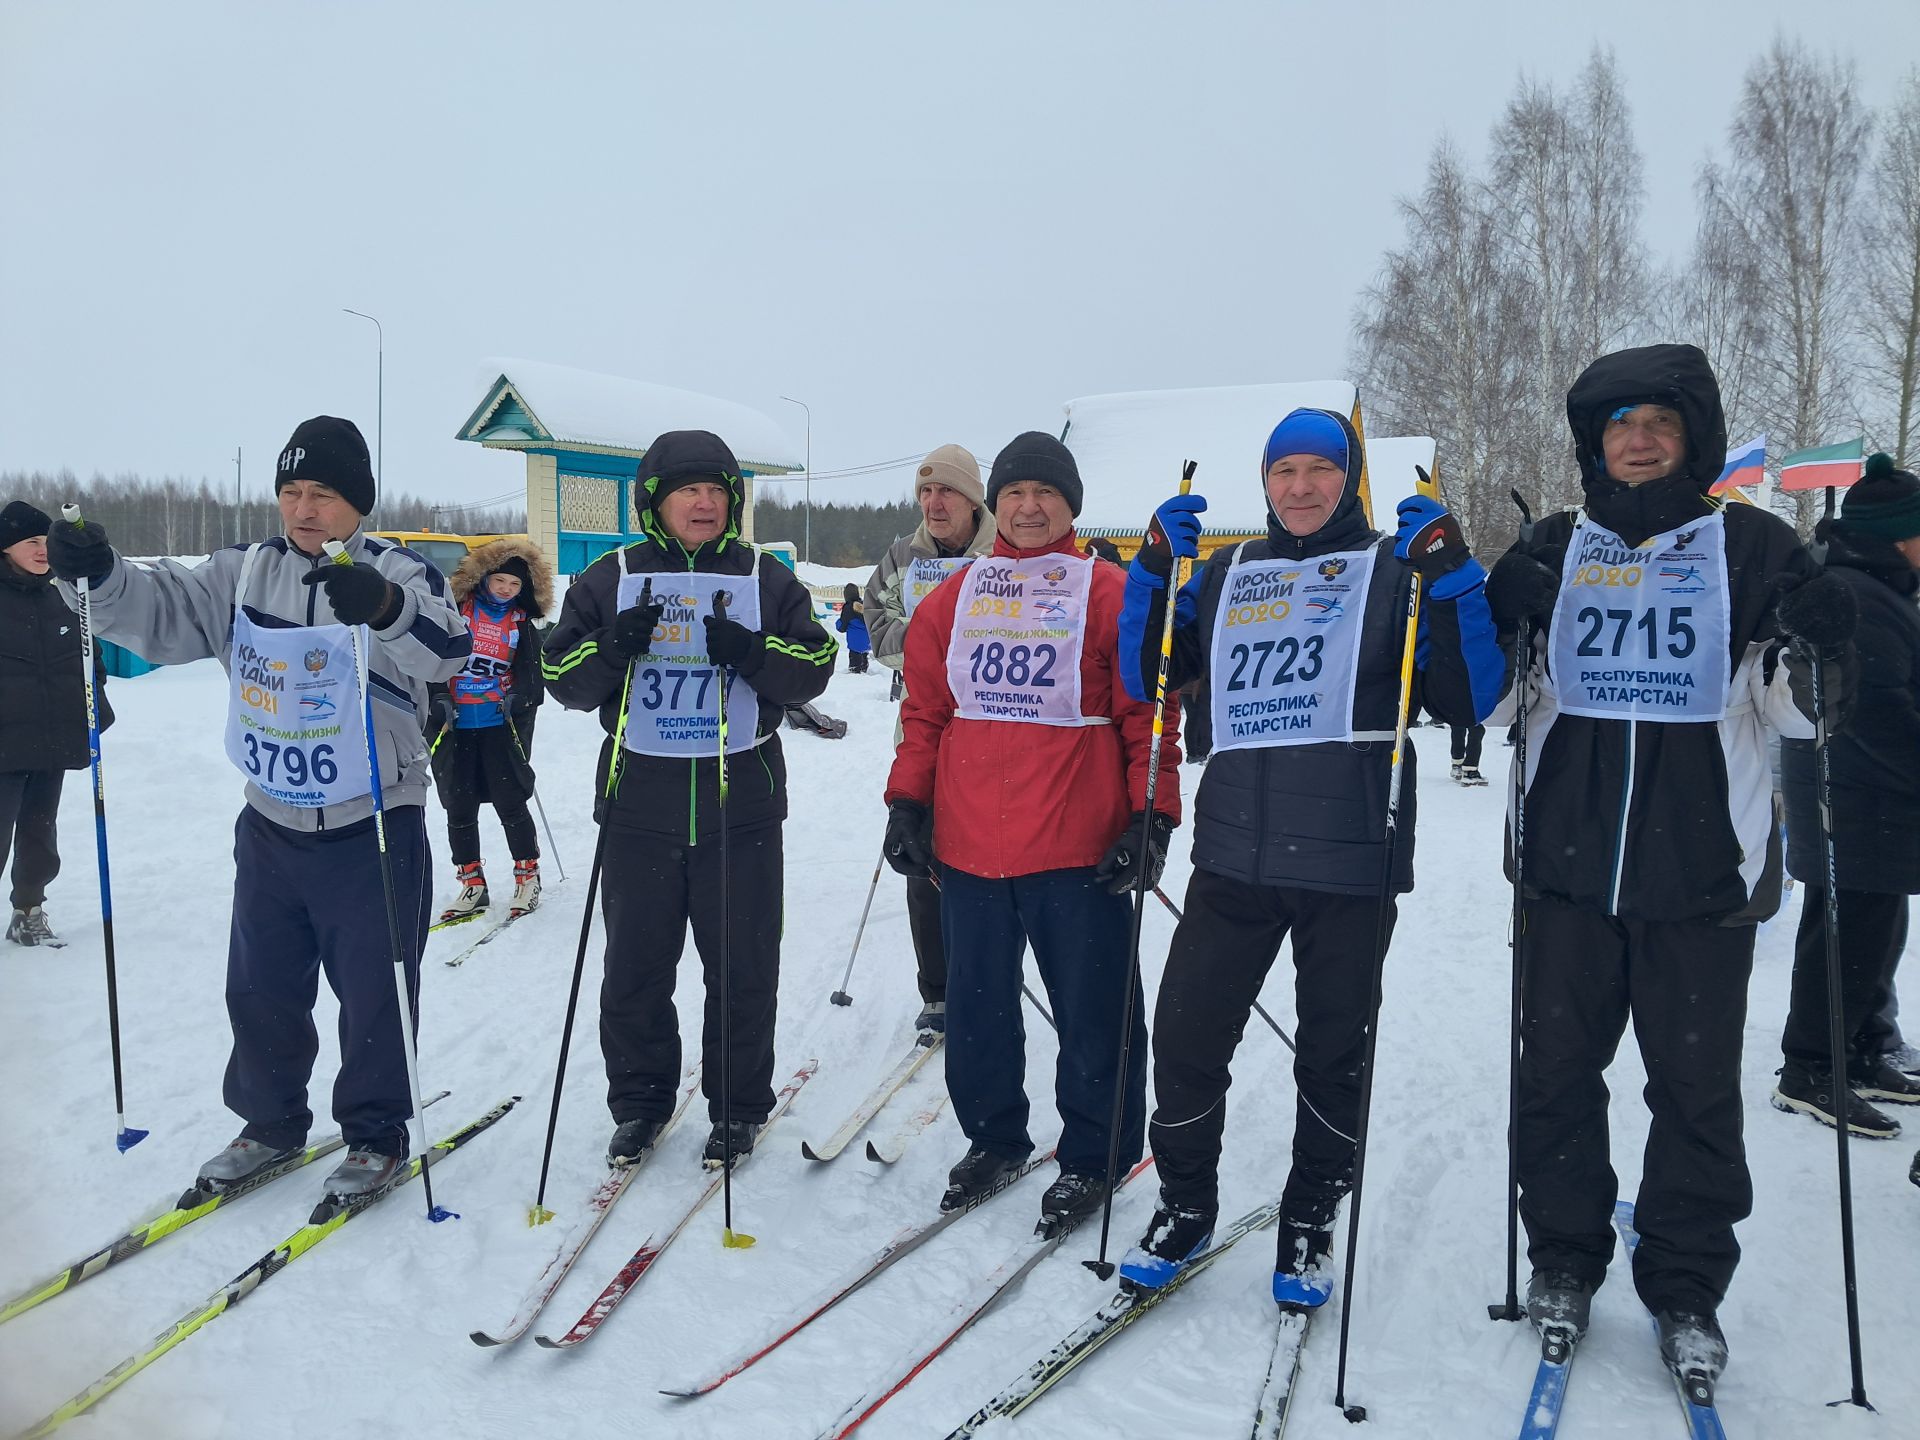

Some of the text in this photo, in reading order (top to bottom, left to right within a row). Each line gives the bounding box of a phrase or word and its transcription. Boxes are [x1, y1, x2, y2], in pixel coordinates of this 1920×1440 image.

[280, 447, 306, 473] HP
[1578, 548, 1652, 565] НАЦИИ
[976, 566, 1012, 583] КРОСС
[1234, 571, 1282, 591] КРОСС
[1572, 564, 1643, 587] 2020
[974, 583, 1023, 598] НАЦИИ
[1229, 582, 1294, 606] НАЦИИ
[1407, 574, 1418, 617] STC
[659, 609, 695, 623] ЦИИ
[967, 597, 1023, 619] 2022
[1225, 600, 1290, 627] 2020
[79, 591, 90, 658] GERMINA
[651, 624, 690, 643] 021
[1577, 606, 1696, 660] 2715
[970, 642, 1057, 687] 1882
[1227, 635, 1324, 692] 2723
[641, 669, 738, 710] 3777
[1154, 653, 1171, 722] STC
[1581, 671, 1695, 688] РЕСПУБЛИКА
[240, 683, 278, 715] 2021
[974, 691, 1043, 705] РЕСПУБЛИКА
[1228, 694, 1319, 719] РЕСПУБЛИКА
[1586, 687, 1688, 706] ТАТАРСТАН
[980, 704, 1039, 718] ТАТАРСТАН
[301, 725, 341, 740] ЖИЗНИ
[659, 730, 719, 740] ТАТАРСТАН
[1231, 714, 1311, 737] ТАТАРСТАН
[244, 733, 338, 787] 3796
[1823, 745, 1831, 782] NORDIC
[375, 810, 387, 853] GERMINA
[1518, 792, 1526, 851] SWIX
[1828, 838, 1837, 901] SWIX
[223, 1161, 297, 1201] SABLE
[1122, 1270, 1188, 1331] FISCHER
